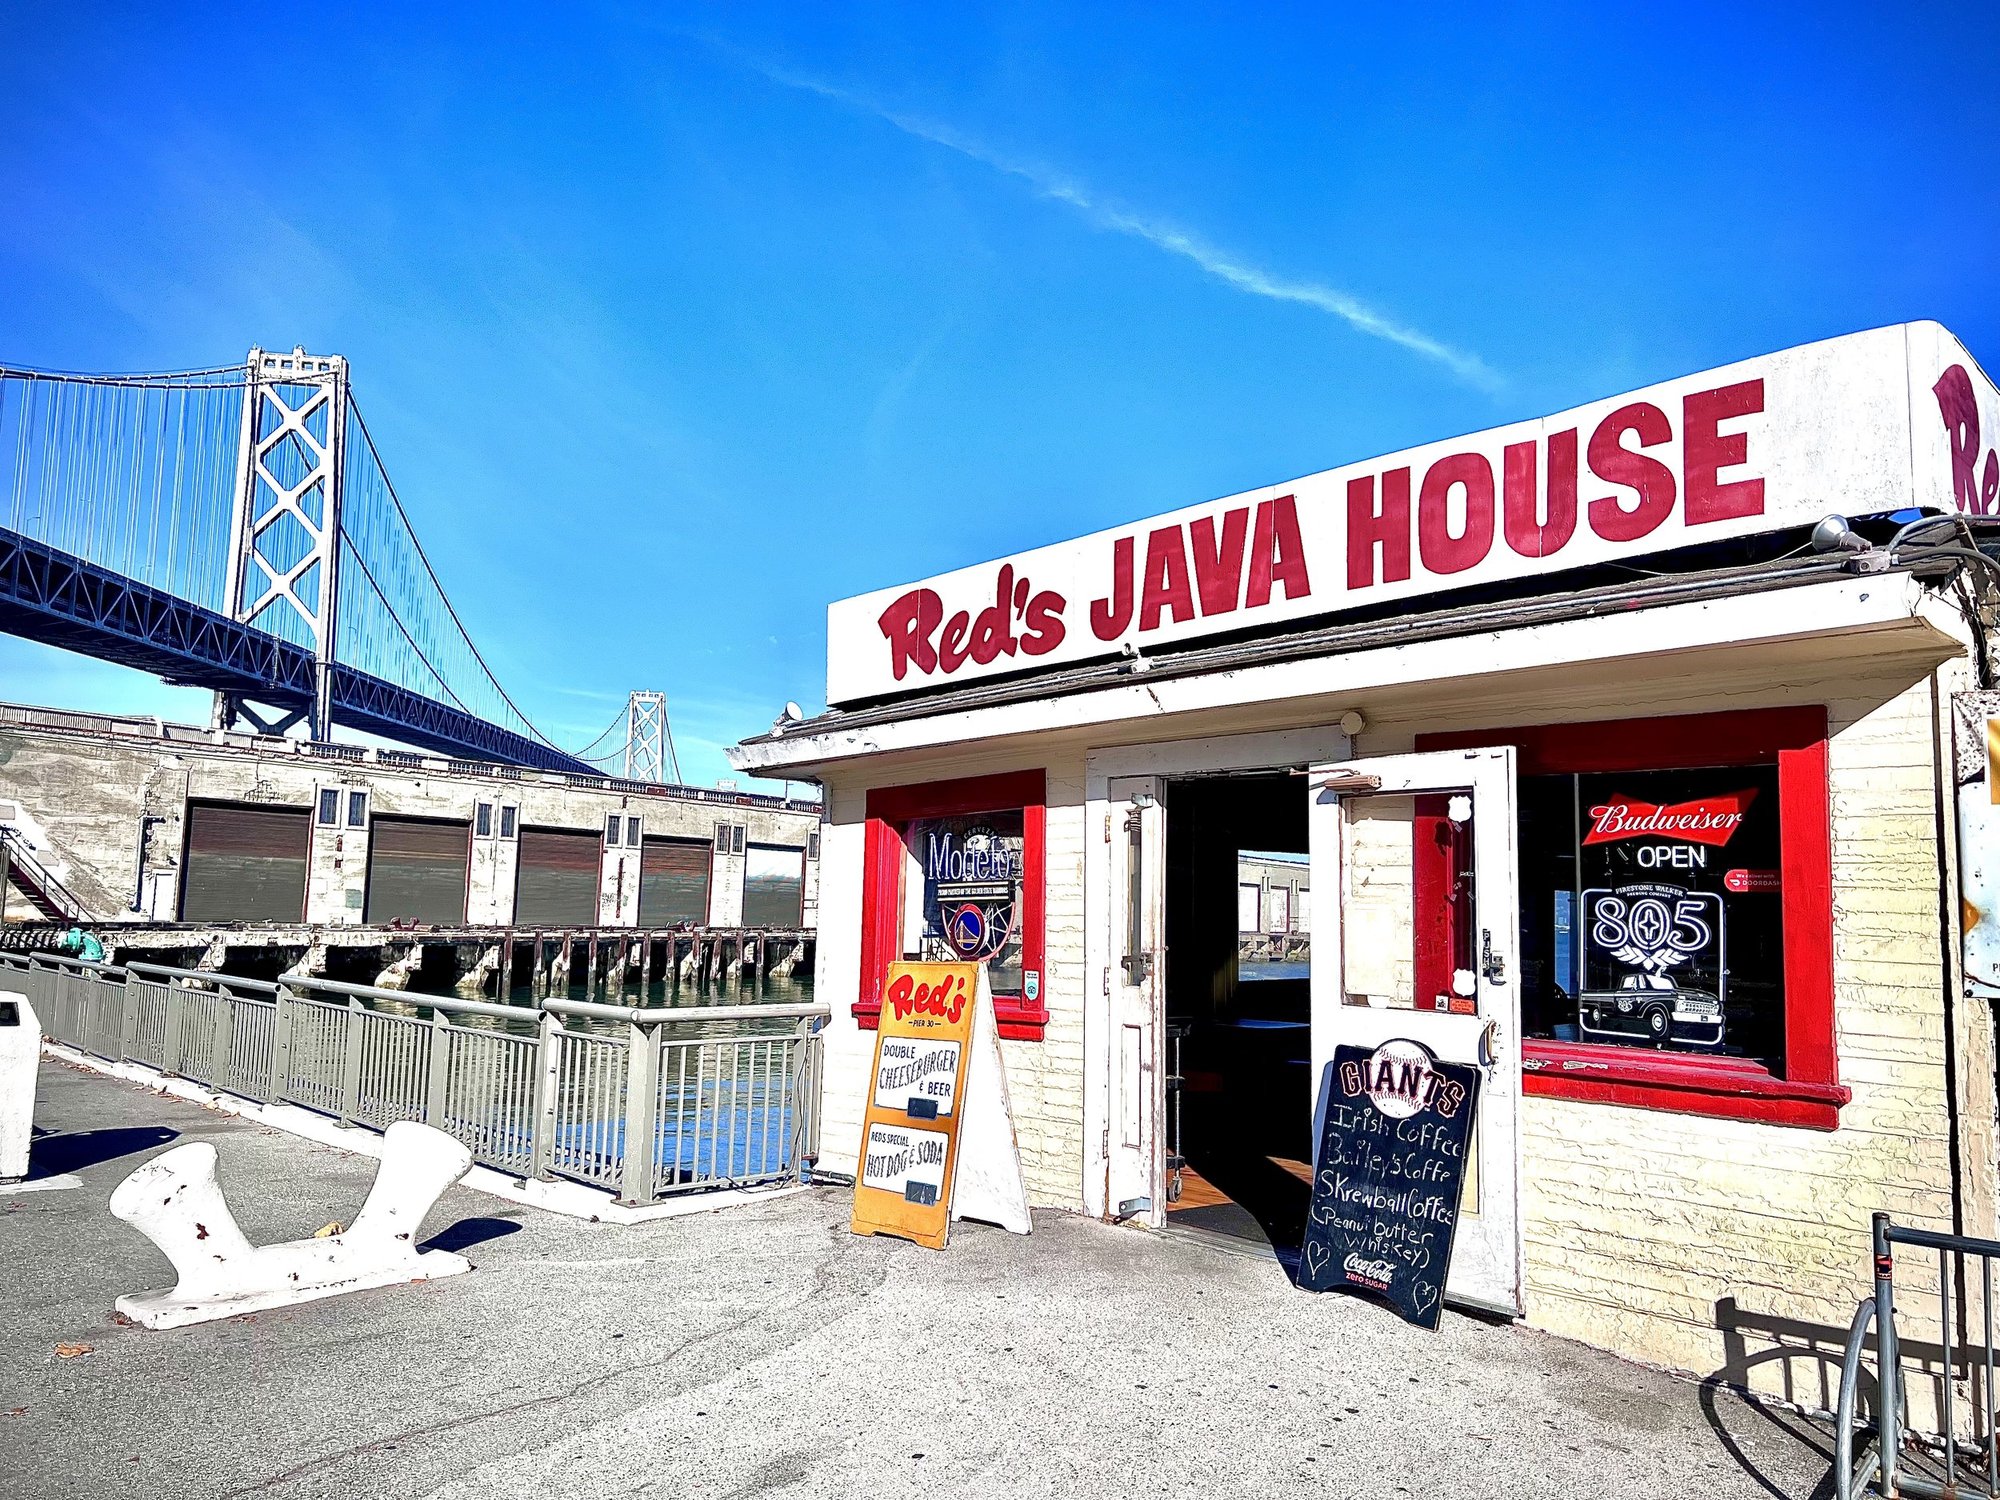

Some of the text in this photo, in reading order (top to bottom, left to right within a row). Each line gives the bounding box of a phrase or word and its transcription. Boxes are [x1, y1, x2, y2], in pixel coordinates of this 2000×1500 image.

[878, 378, 1764, 681] Red's JAVA HOUSE
[963, 826, 995, 839] CERVEZA
[1590, 804, 1743, 833] Budweiser
[928, 832, 1009, 880] Modelo
[1637, 845, 1705, 868] OPEN
[1615, 885, 1683, 897] FIRESTONE WALKER
[1593, 897, 1711, 951] 805
[888, 974, 966, 1024] Red's
[884, 1044, 916, 1059] DOUBLE
[879, 1049, 957, 1091] CHEESEBURGER
[928, 1081, 951, 1097] BEER
[1339, 1058, 1466, 1119] GIANTS
[1329, 1103, 1390, 1136] Irish
[886, 1133, 909, 1147] SPECIAL
[866, 1154, 887, 1178] HOT
[886, 1149, 908, 1178] DOG
[916, 1140, 944, 1166] SODA
[1327, 1132, 1402, 1180] Bailey's
[1373, 1215, 1434, 1244] butter
[1345, 1272, 1388, 1291] zero SUGAR
